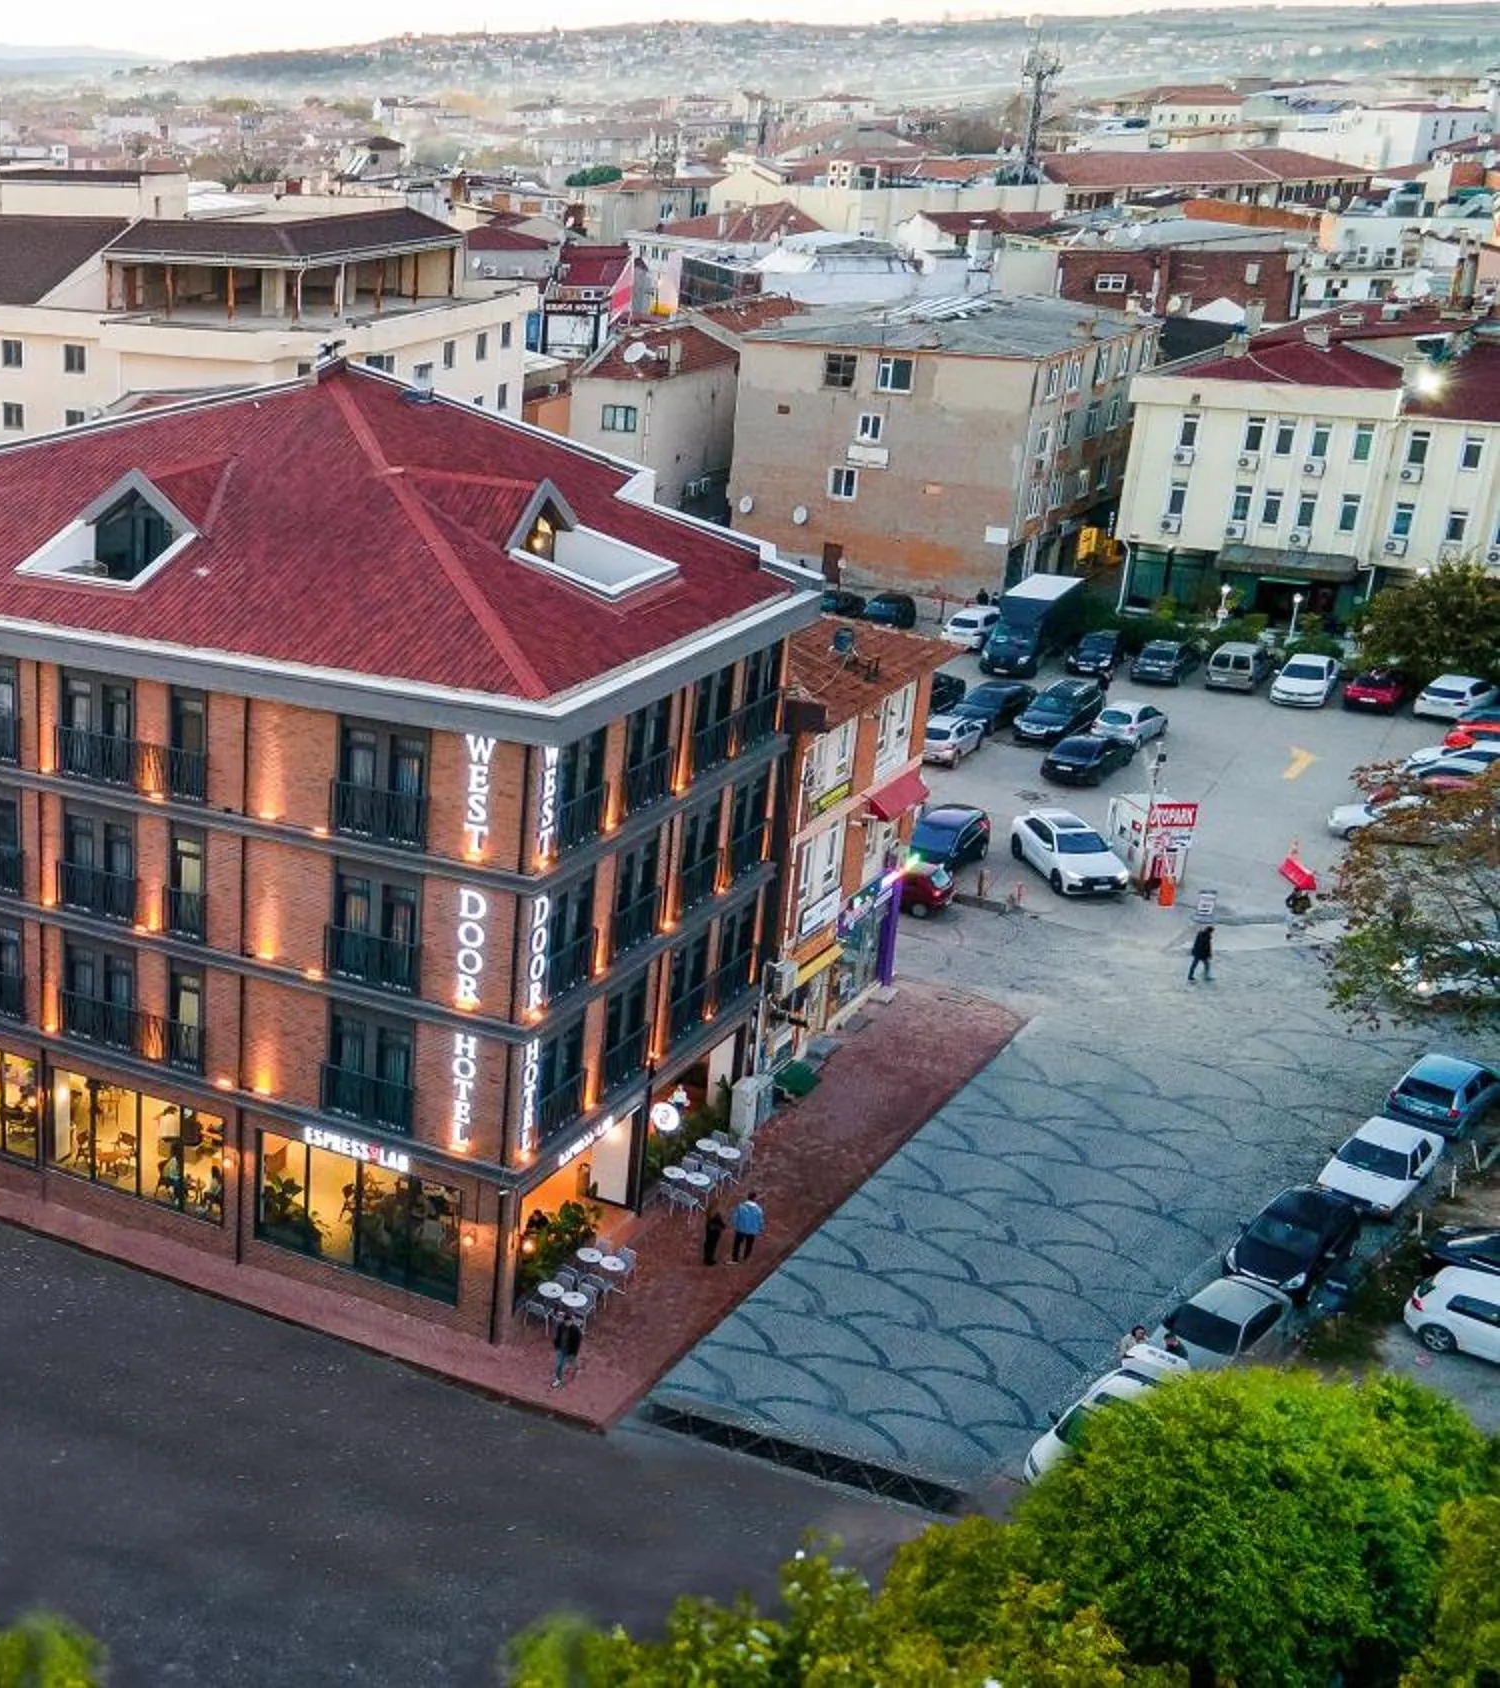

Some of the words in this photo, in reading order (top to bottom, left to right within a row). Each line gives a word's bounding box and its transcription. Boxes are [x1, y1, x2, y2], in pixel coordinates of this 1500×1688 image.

[464, 734, 497, 857] WEST
[538, 746, 559, 859] WEST
[457, 888, 487, 1007] DOOR
[529, 896, 549, 1010] DOOR
[451, 1033, 477, 1151] HOTEL
[520, 1038, 540, 1153] HOTEL
